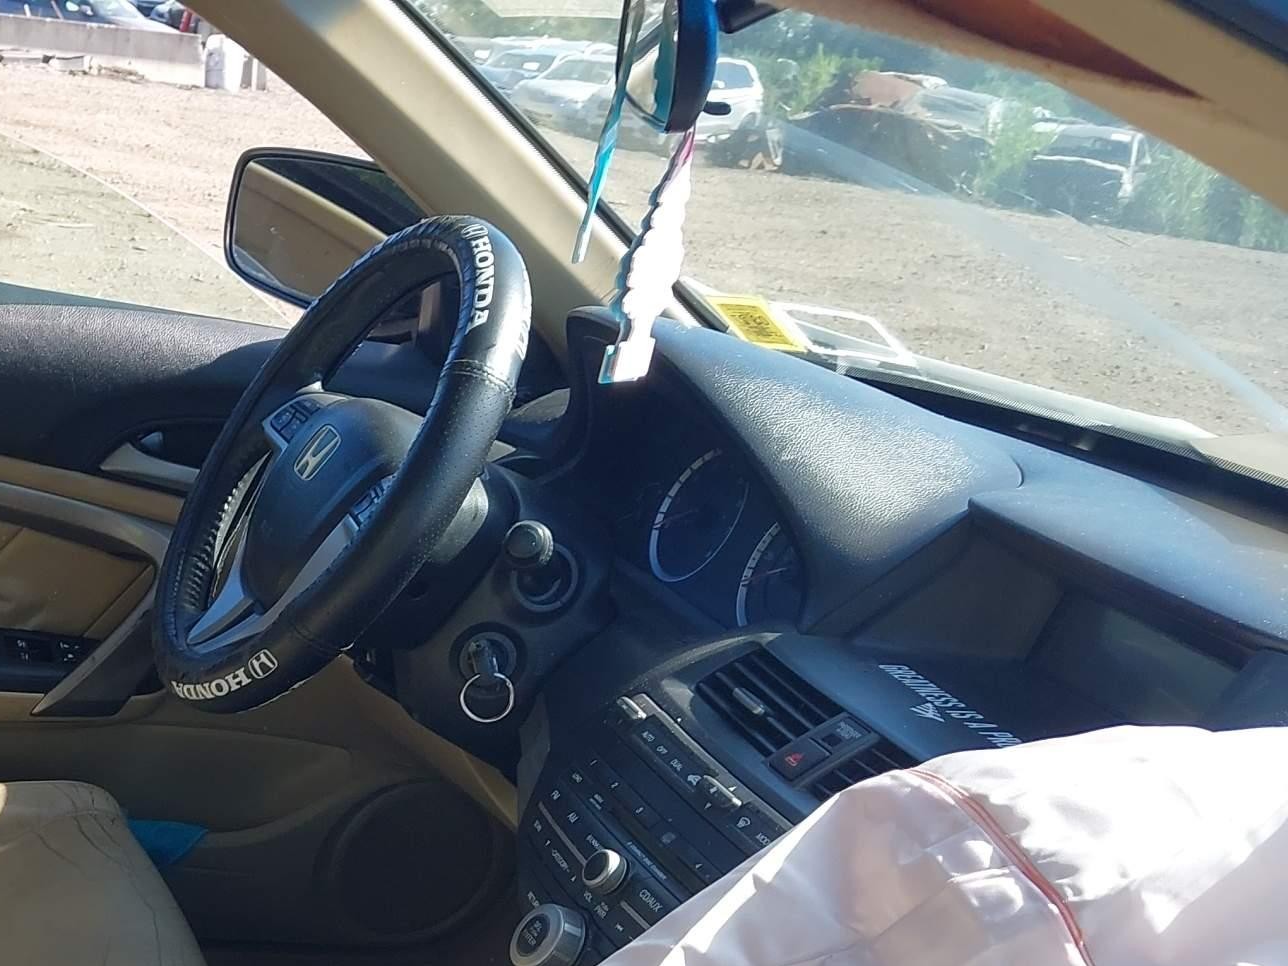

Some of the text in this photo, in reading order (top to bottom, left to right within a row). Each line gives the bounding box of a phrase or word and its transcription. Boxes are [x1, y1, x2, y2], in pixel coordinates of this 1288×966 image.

[464, 236, 495, 335] HONDA
[172, 667, 252, 700] HONDA
[878, 664, 966, 708] GREATNESS
[945, 710, 984, 719] IS
[963, 721, 999, 729] A
